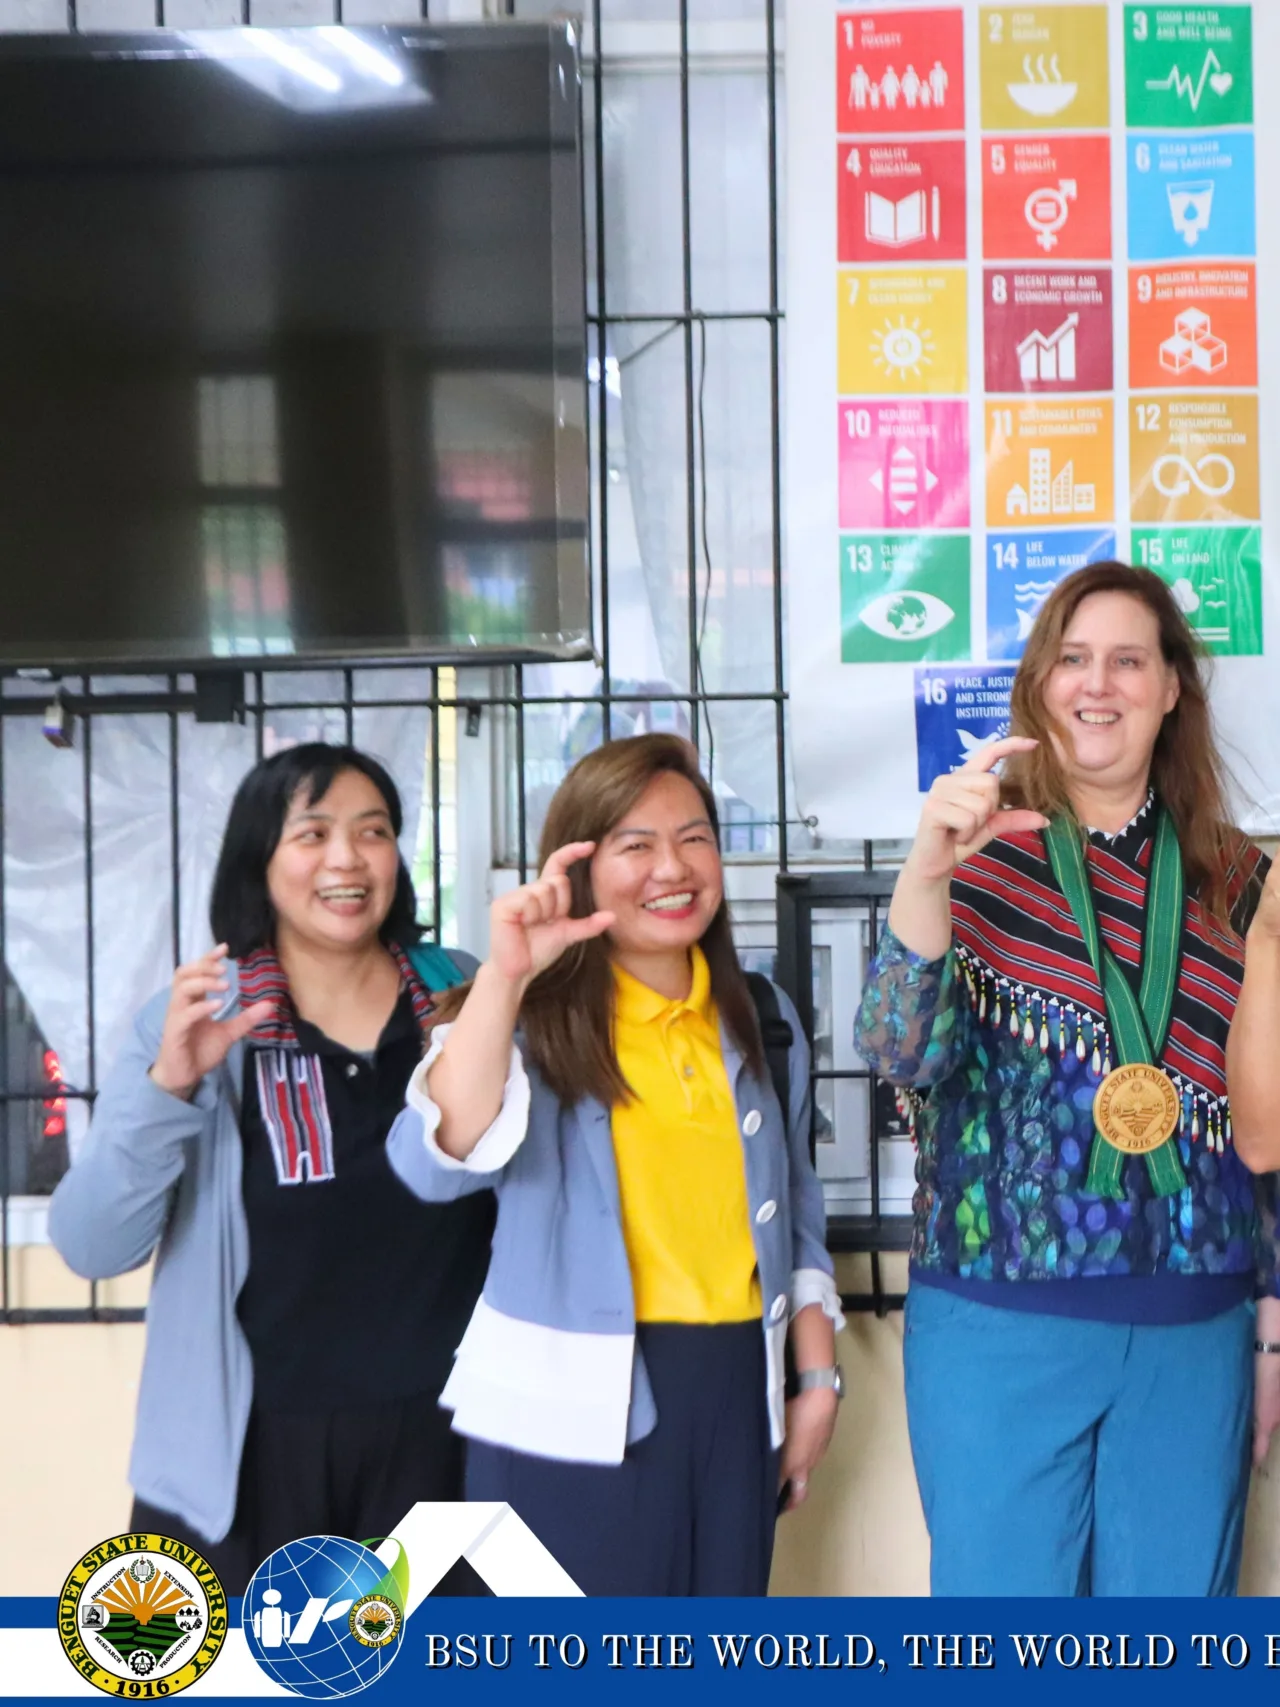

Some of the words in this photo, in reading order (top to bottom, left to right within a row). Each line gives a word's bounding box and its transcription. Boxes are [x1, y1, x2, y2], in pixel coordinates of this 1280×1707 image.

[843, 19, 854, 50] 1
[988, 13, 1003, 43] 2
[1133, 10, 1148, 42] 3
[846, 148, 862, 177] 4
[869, 147, 908, 161] QUALITY
[991, 144, 1006, 175] 5
[1014, 158, 1057, 173] EQUALITY
[1135, 142, 1151, 173] 6
[869, 161, 922, 176] EDUCATION
[846, 278, 859, 307] 7
[992, 274, 1007, 305] 8
[1014, 275, 1046, 288] DECENT
[1049, 275, 1076, 288] WORK
[1078, 275, 1096, 288] AND
[1137, 274, 1152, 304] 9
[1014, 290, 1061, 304] ECONOMIC
[1063, 289, 1103, 304] GROWTH
[844, 409, 871, 439] 10
[992, 409, 1012, 437] 11
[1136, 403, 1160, 431] 12
[992, 541, 1018, 569] 14
[1026, 540, 1043, 553] LIFE
[1138, 538, 1164, 566] 15
[1171, 537, 1188, 549] LIFE
[846, 544, 872, 573] 13
[1026, 555, 1055, 568] BELOW
[1058, 554, 1088, 567] WATER
[1171, 552, 1185, 565] ON
[1189, 551, 1210, 565] LAND
[921, 678, 948, 705] 16
[955, 676, 985, 689] PEACE,
[956, 692, 974, 704] AND
[956, 706, 1011, 719] INSTITUTION
